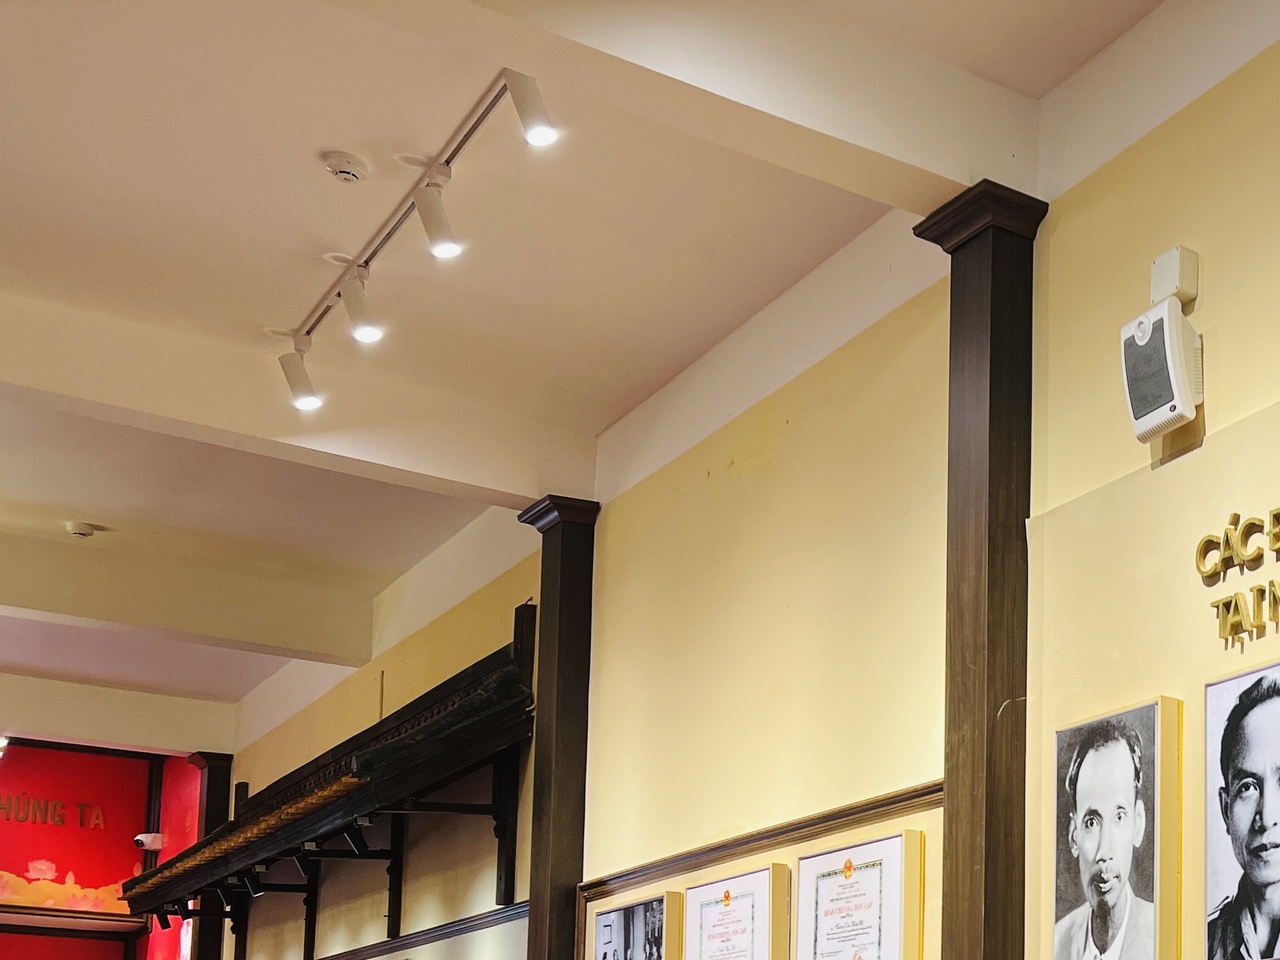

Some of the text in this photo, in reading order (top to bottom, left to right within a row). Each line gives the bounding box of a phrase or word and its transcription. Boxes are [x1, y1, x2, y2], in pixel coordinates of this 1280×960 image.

[1195, 513, 1265, 578] CÁC
[1211, 585, 1266, 646] TẠI
[75, 803, 105, 829] TA
